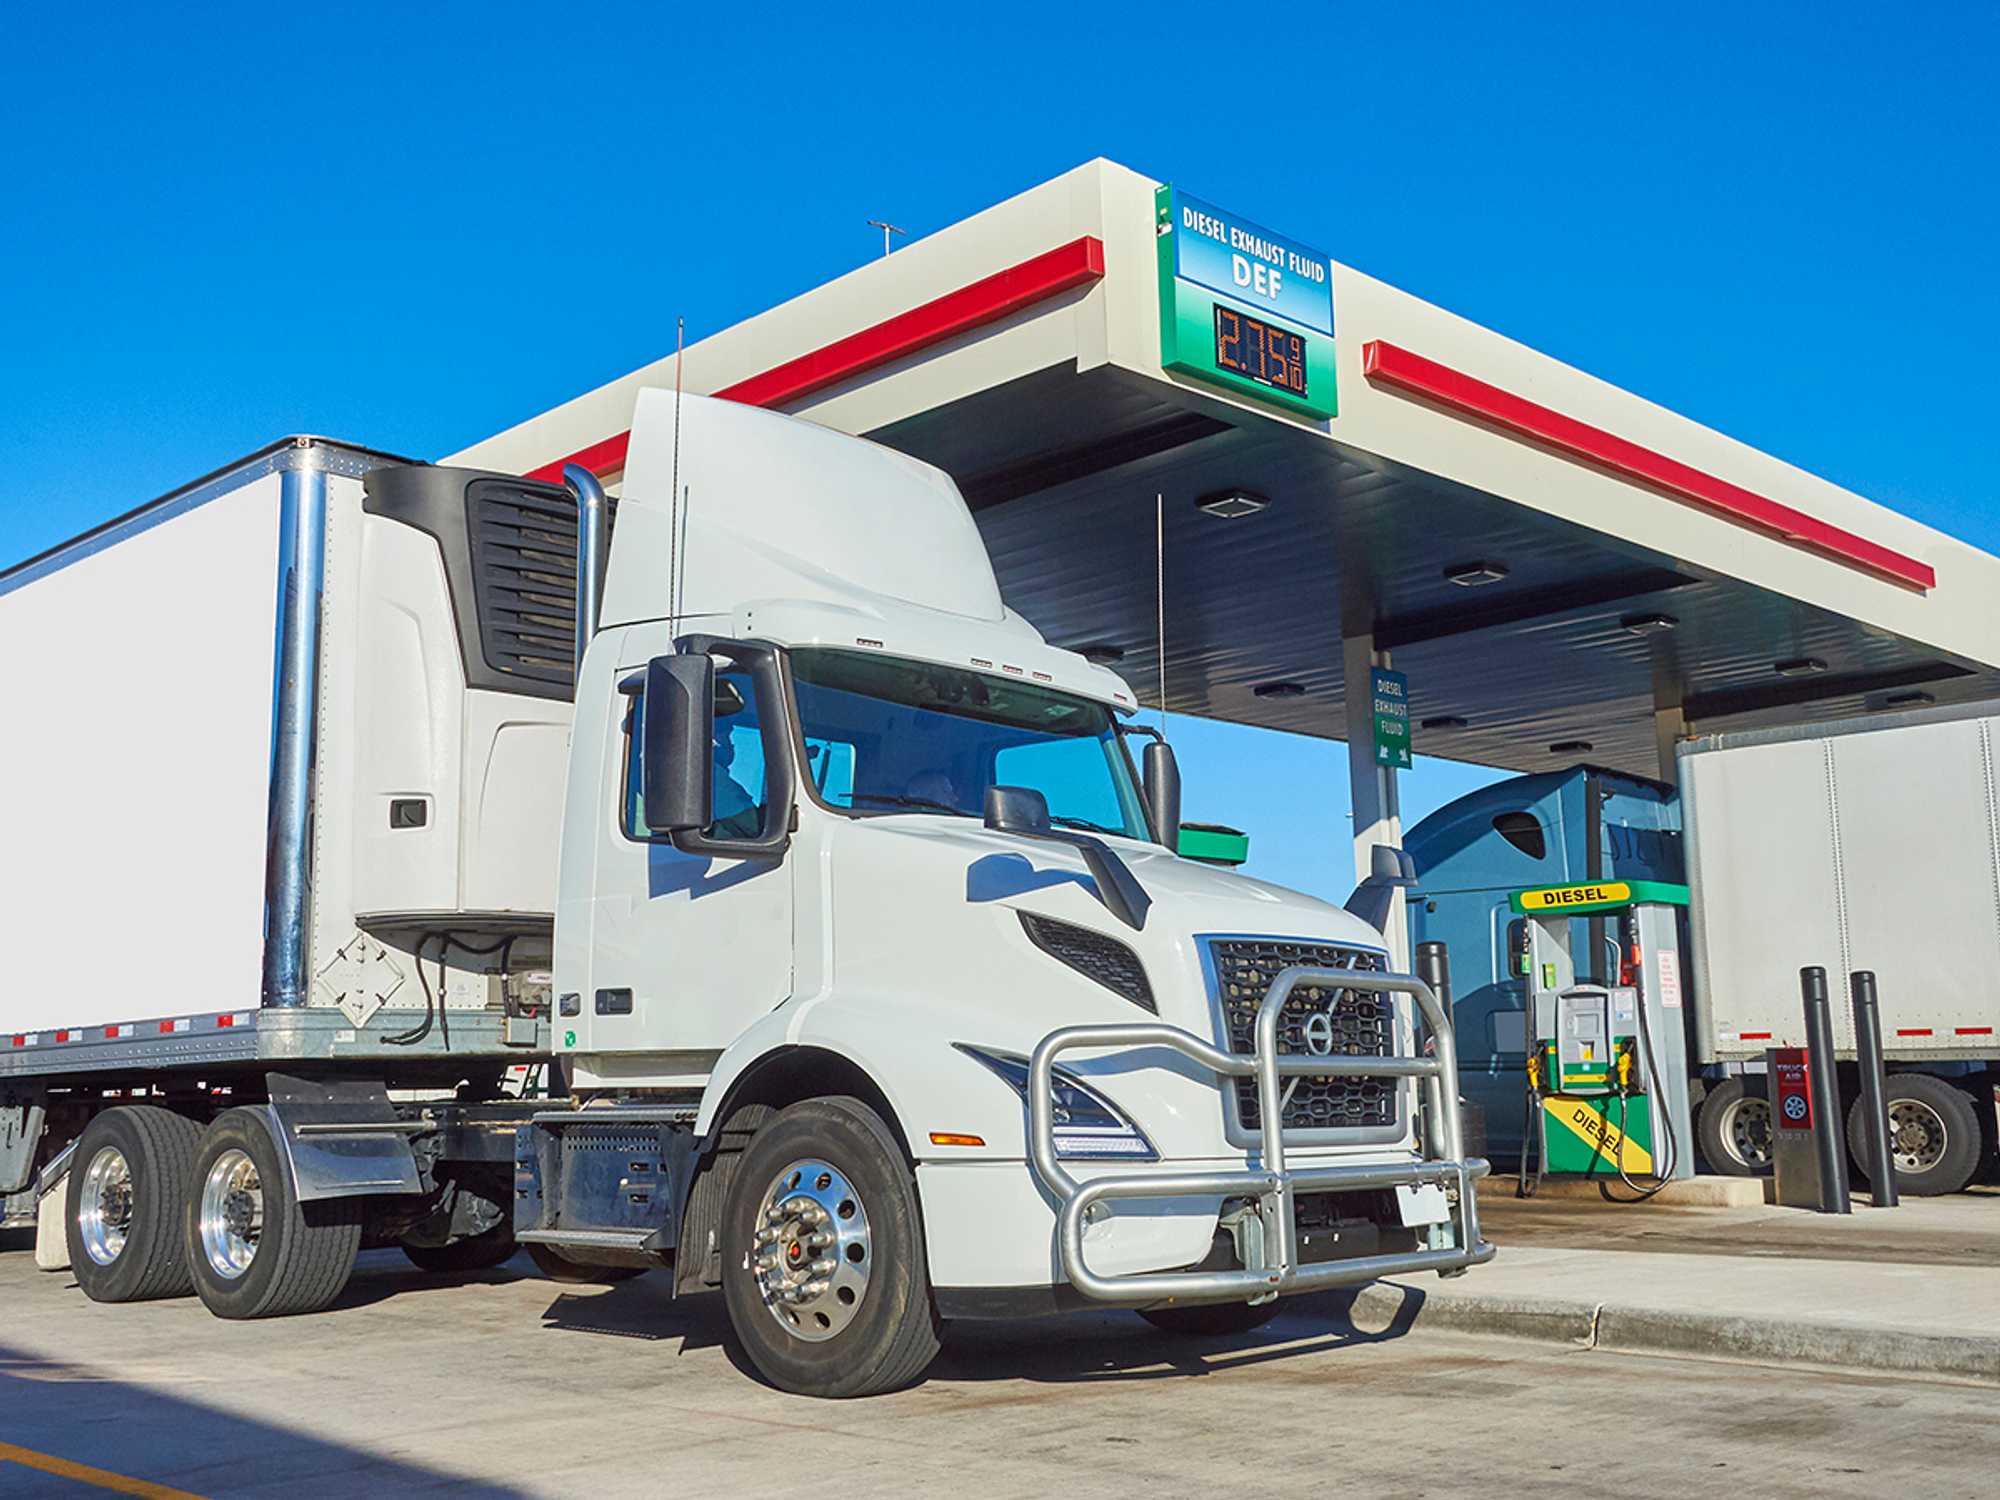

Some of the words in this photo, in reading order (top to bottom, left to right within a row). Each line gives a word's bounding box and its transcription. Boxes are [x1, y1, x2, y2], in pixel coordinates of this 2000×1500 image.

[1183, 207, 1227, 242] DIESEL
[1231, 227, 1285, 267] EXHAUST
[1289, 253, 1324, 282] FLUID
[1232, 254, 1281, 299] DEF
[1377, 679, 1402, 696] DIESEL
[1375, 699, 1406, 716] EXHAUST
[1382, 720, 1404, 736] FLUID
[1543, 888, 1608, 904] DIESEL
